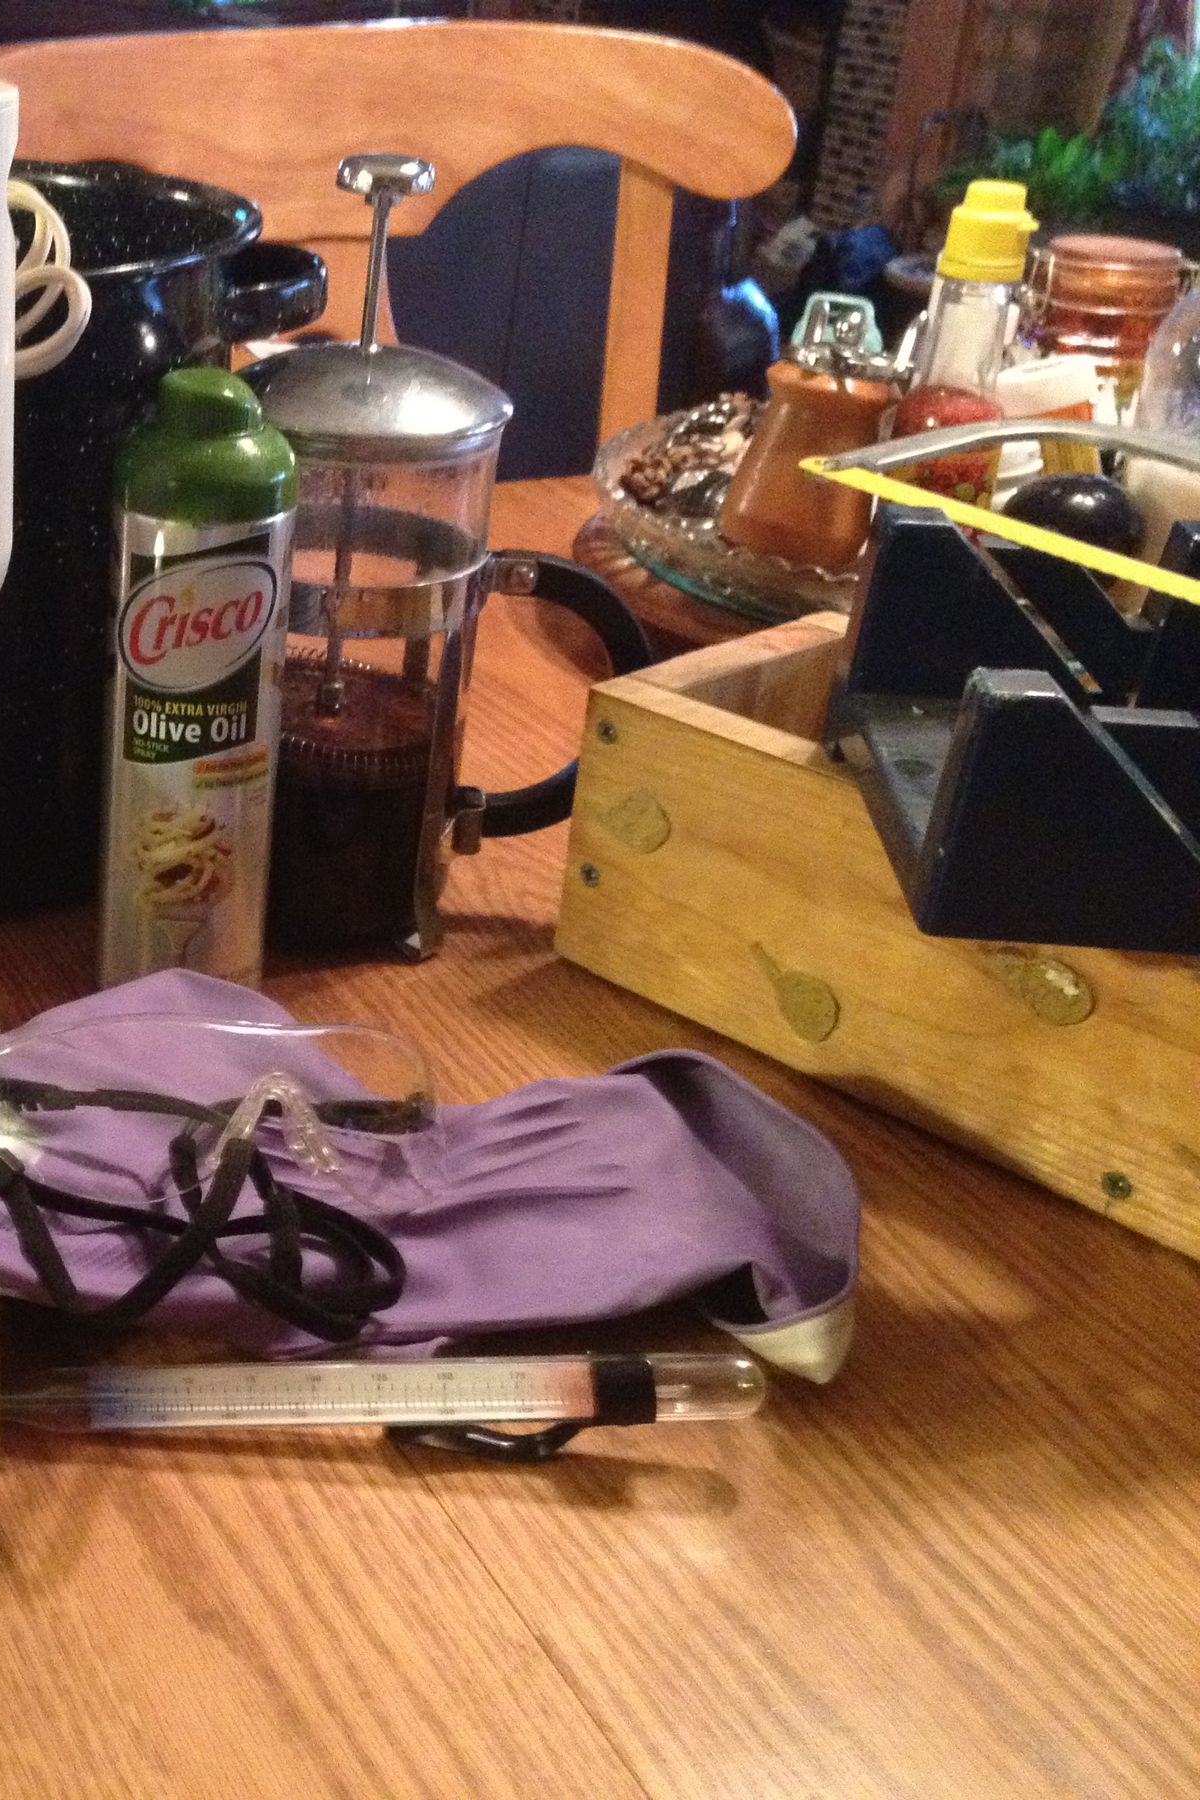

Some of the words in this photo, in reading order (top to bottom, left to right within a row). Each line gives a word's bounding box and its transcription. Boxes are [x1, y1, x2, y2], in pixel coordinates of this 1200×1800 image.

[129, 590, 264, 666] Crisco
[164, 701, 204, 717] EXTRA
[207, 700, 248, 717] VIRGIN
[133, 709, 202, 743] Olive
[210, 713, 248, 743] Oil
